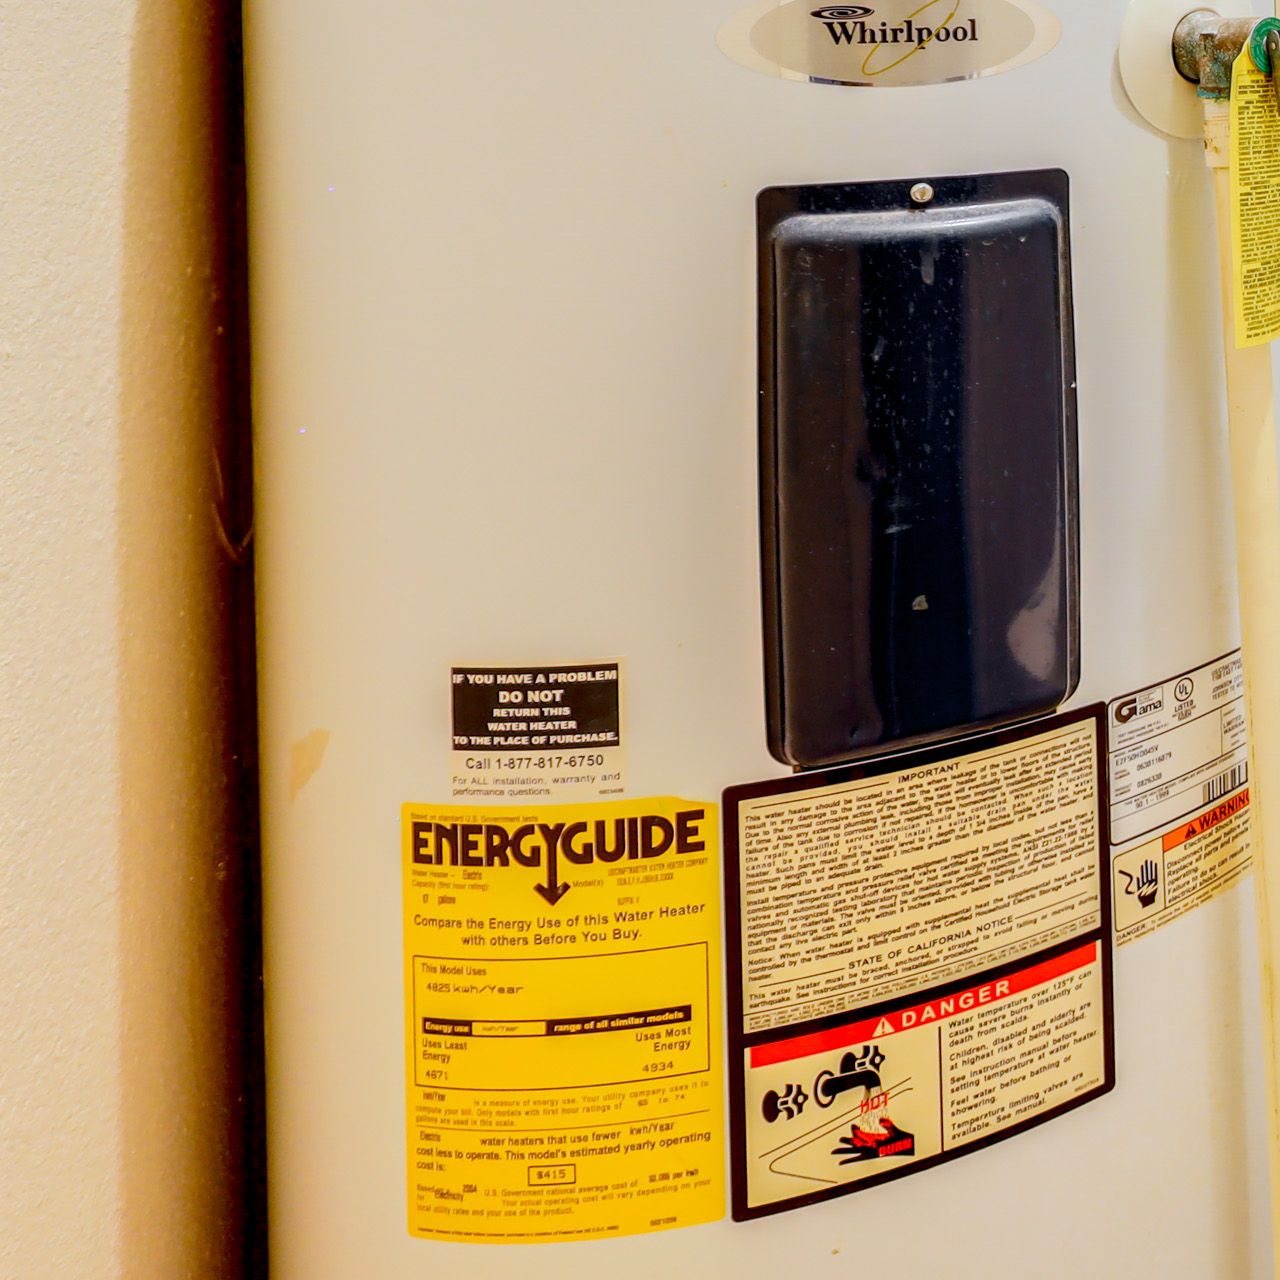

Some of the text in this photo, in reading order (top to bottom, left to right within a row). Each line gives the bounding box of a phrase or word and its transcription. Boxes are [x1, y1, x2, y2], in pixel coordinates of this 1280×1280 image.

[823, 19, 978, 49] Whirlpool
[452, 670, 617, 684] IF YOU HAVE A PROBLEM
[498, 689, 564, 703] DO NOT
[493, 706, 571, 717] RETURN THIS
[487, 720, 577, 731] WATER HEATER
[453, 731, 618, 745] TO THE PLACE OF PURCHASE.
[465, 754, 604, 770] Call 1-877-817-6750
[452, 776, 467, 785] For
[470, 777, 488, 785] ALL
[552, 774, 596, 784] warranty
[601, 772, 621, 782] and
[898, 761, 960, 783] IMPORTANT
[412, 809, 705, 867] ENERGYGUIDE
[1184, 830, 1213, 850] Electrical
[413, 904, 705, 931] Compare the Energy Use of this Water Heater
[461, 928, 642, 946] with others Before You Buy.
[848, 914, 1013, 969] STATE OF CALIFORNIA NOTICE
[421, 963, 487, 976] This Model Uses
[902, 980, 1010, 1028] DANGER
[949, 1015, 973, 1029] Water
[977, 997, 1028, 1018] temperature
[1031, 989, 1049, 1000] over
[1079, 970, 1092, 980] can
[948, 982, 1083, 1038] cause severe burns instantly or
[425, 1011, 684, 1033] Energy use range of all similar models
[635, 1026, 692, 1042] Uses Most
[949, 1016, 1028, 1048] death from scalds.
[422, 1038, 468, 1051] Uses Least
[653, 1040, 691, 1052] Energy
[422, 1050, 451, 1064] Energy
[642, 1061, 674, 1072] 4934
[950, 1055, 1071, 1108] Feel water before bathing or
[860, 1091, 889, 1113] HOT
[951, 1096, 998, 1117] showering.
[480, 1137, 505, 1146] water
[508, 1136, 544, 1146] heaters
[547, 1135, 567, 1145] that
[570, 1135, 588, 1143] use
[591, 1130, 621, 1141] fewer
[536, 1169, 566, 1179] $415
